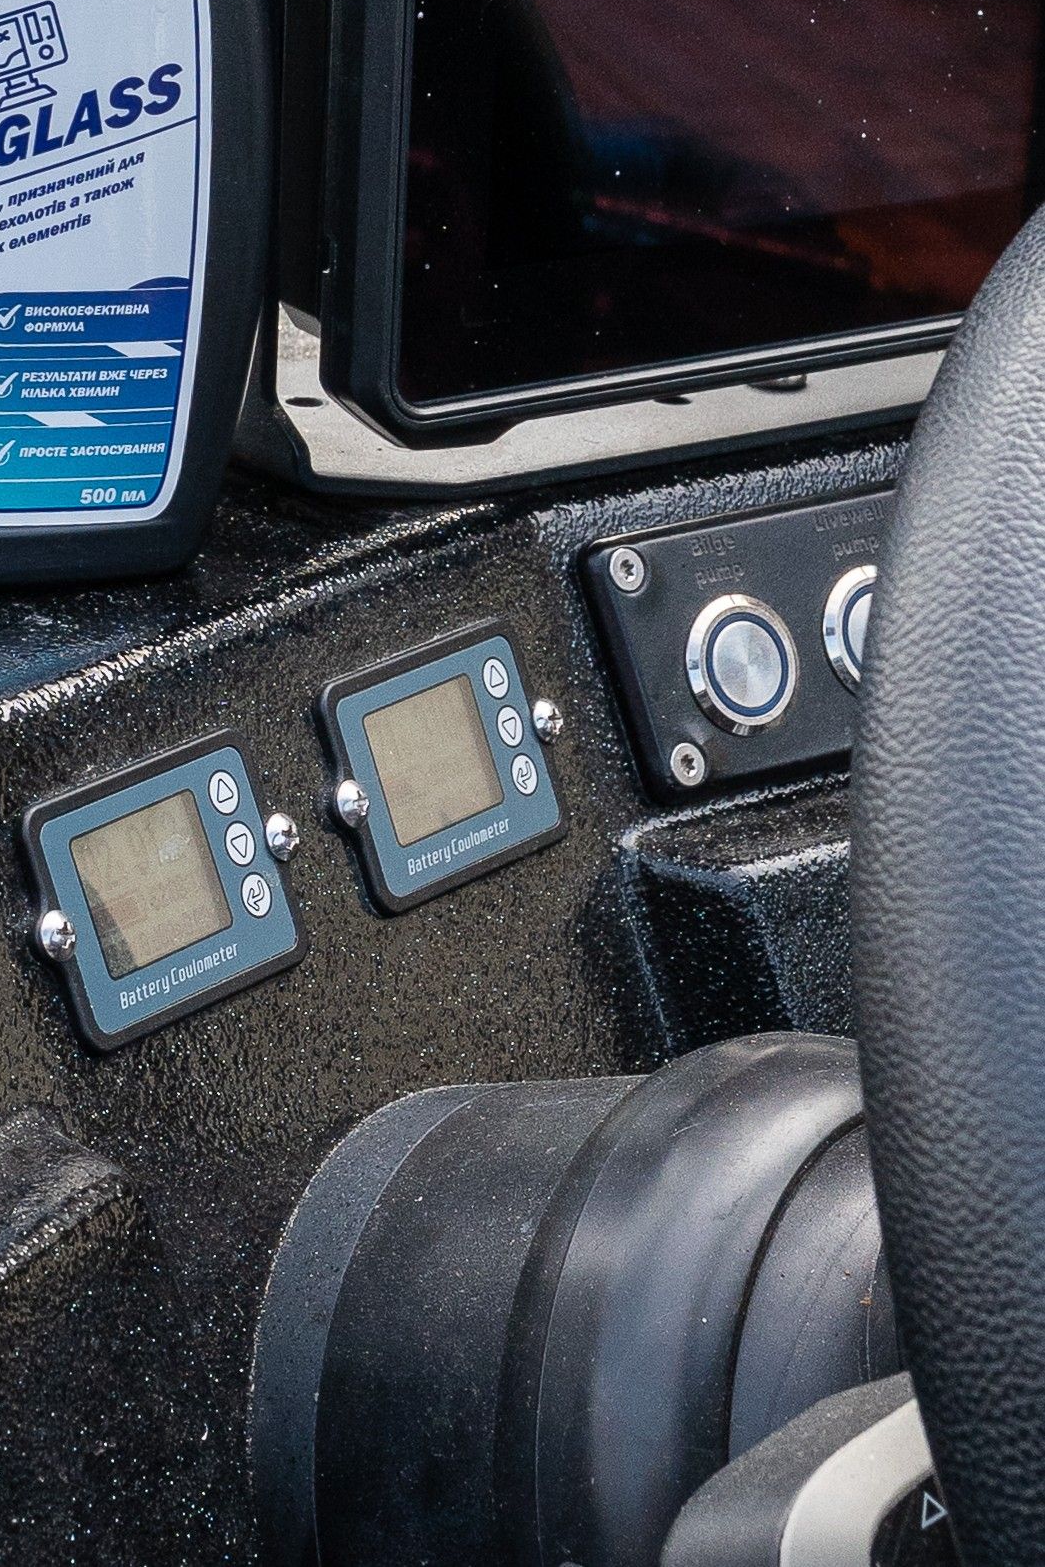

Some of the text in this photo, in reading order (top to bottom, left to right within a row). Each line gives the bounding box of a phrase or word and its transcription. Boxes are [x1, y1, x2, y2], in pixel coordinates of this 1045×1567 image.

[7, 158, 115, 207] призначений
[117, 151, 145, 174] для
[69, 194, 80, 209] а
[83, 176, 135, 204] також
[8, 213, 92, 251] елементів
[24, 304, 150, 317] ВИСОКОЕФЕКТИВНА
[24, 321, 85, 333] ФОРМУЛА
[21, 368, 168, 382] РЕЗУЛЬТАТИ ВЖЕ ЧЕРЕЗ
[20, 385, 120, 399] КІЛЬКА ХВИЛИН
[18, 442, 165, 458] ПРОСТЕ ЗАСТОСУВАННЯ
[79, 487, 116, 504] 500
[812, 499, 886, 533] Livewell
[832, 533, 880, 562] pump
[406, 816, 510, 876] Battery Coulometer
[118, 941, 239, 1010] Battery Coulometer
